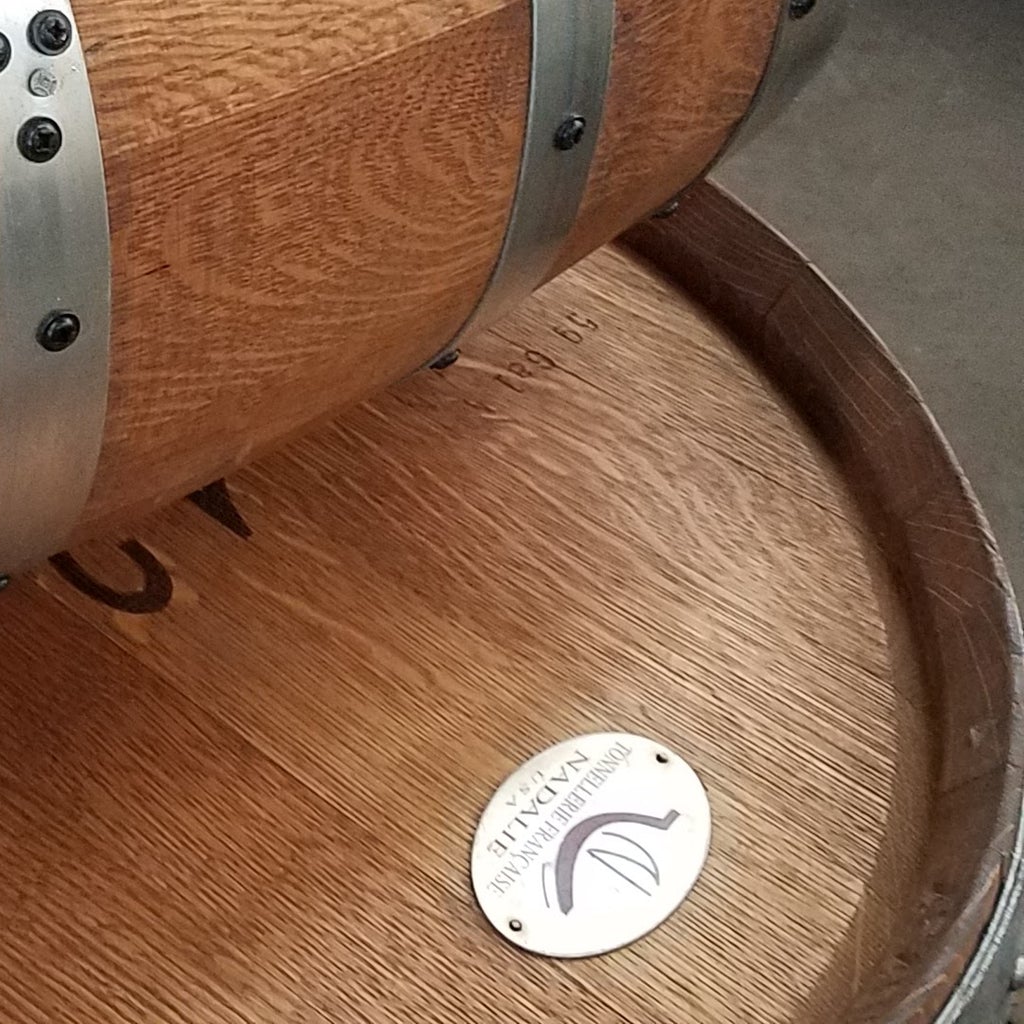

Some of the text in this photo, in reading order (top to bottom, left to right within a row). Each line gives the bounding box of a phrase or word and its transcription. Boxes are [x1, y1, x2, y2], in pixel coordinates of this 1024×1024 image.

[487, 750, 589, 857] NADALIE
[490, 741, 632, 895] TONNELLERIE FRANÇAISE
